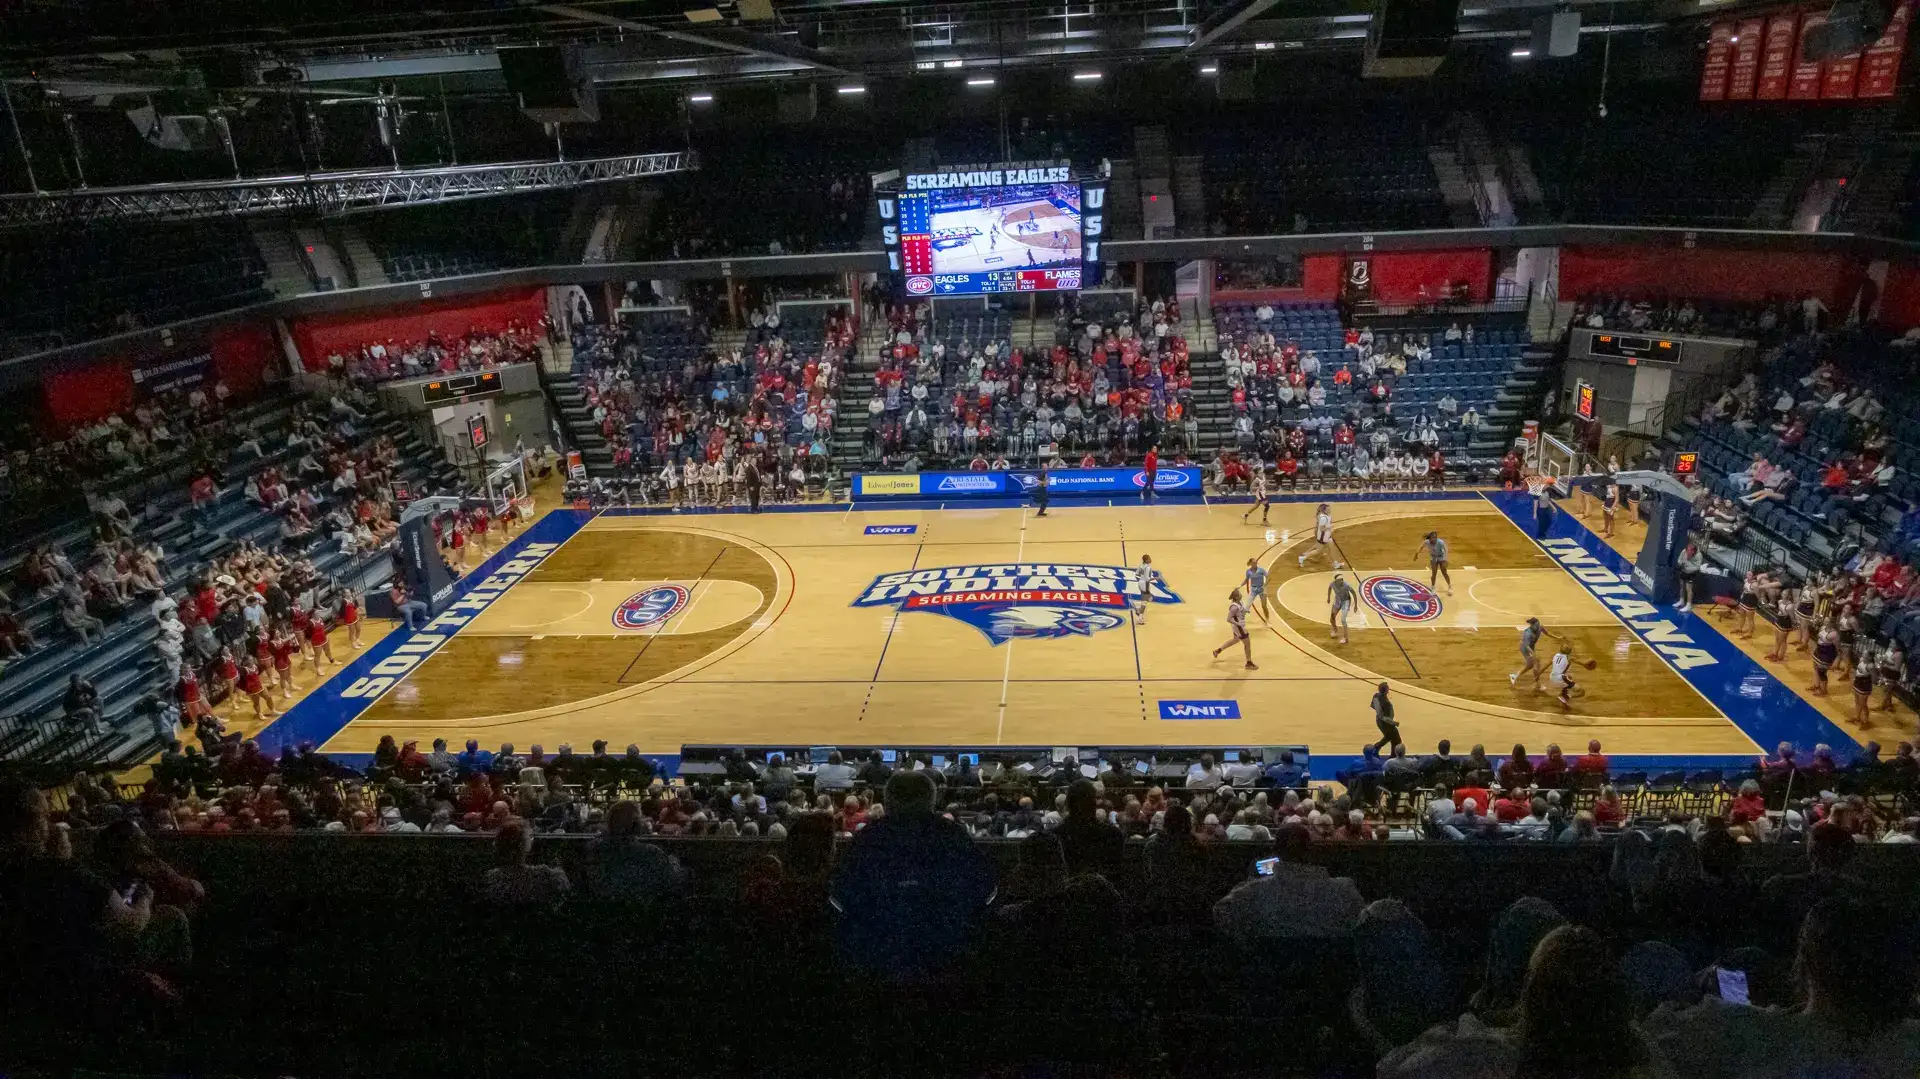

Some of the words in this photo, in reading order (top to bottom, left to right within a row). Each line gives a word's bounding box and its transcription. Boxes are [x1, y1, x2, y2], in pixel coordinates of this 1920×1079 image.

[906, 171, 1002, 190] SCREAMING
[1006, 167, 1069, 186] EAGLES
[935, 274, 970, 284] EAGLES
[988, 272, 998, 281] 13
[1045, 270, 1080, 279] FLAMES
[1678, 462, 1690, 470] 25
[1665, 509, 1676, 550] TicketSmarter
[876, 564, 1158, 588] SOUTHERN
[861, 576, 1173, 602] INDIANA
[918, 591, 1032, 605] SCREAMING
[1042, 591, 1111, 603] EAGLES
[1378, 584, 1424, 612] OVC
[632, 592, 672, 620] OVC
[1538, 537, 1720, 670] INDIANA
[340, 542, 560, 698] SOUTHERN
[1167, 705, 1230, 716] WNIT
